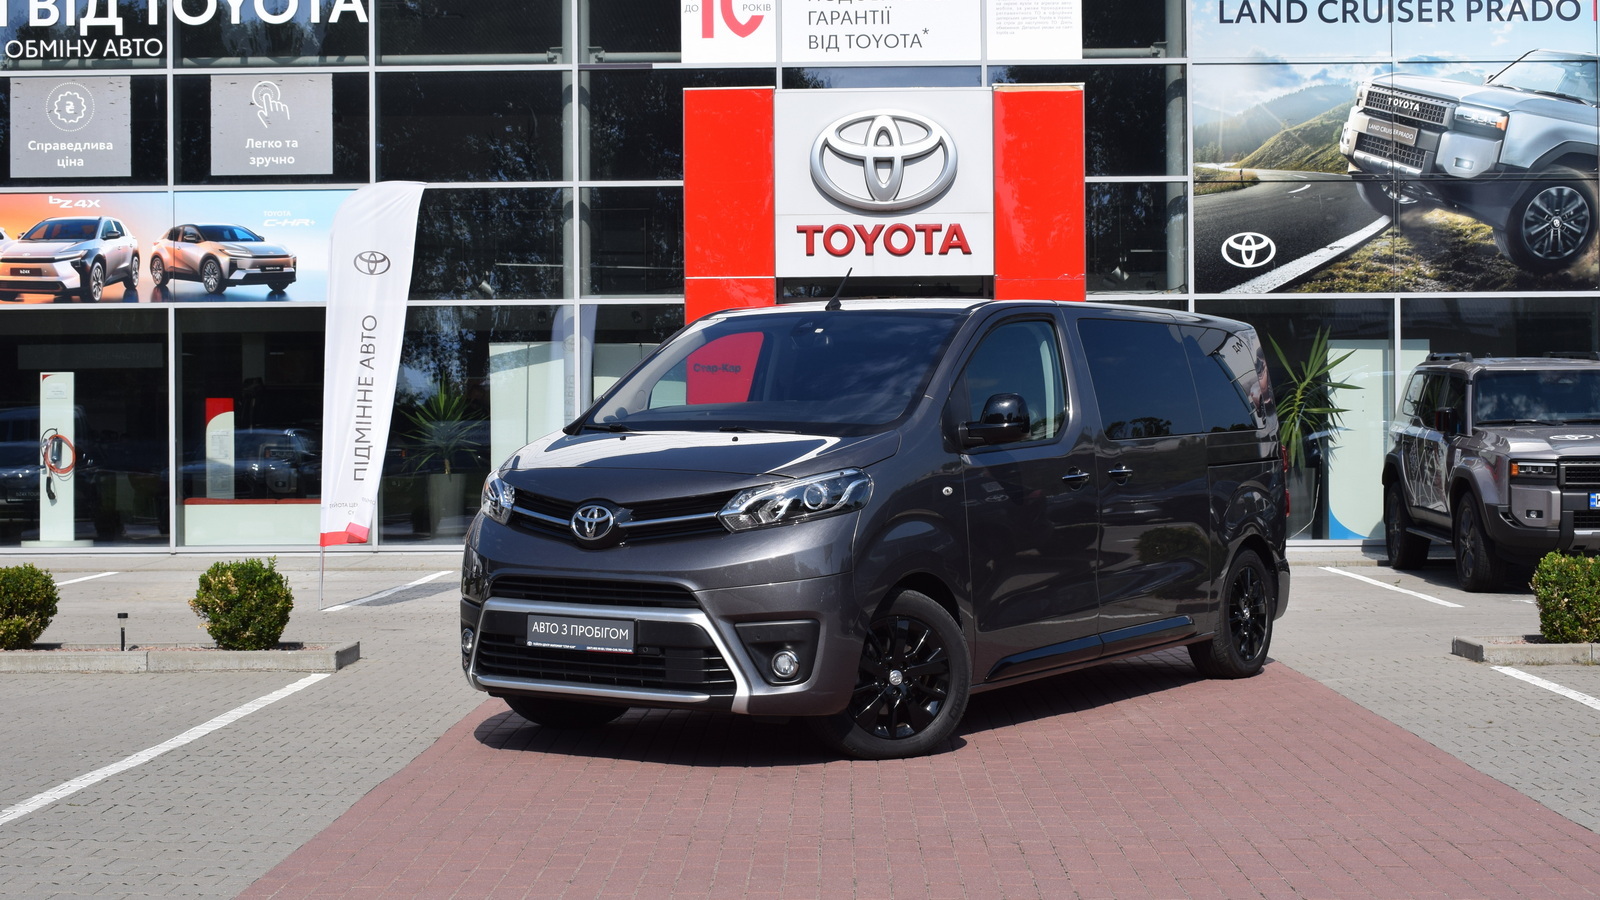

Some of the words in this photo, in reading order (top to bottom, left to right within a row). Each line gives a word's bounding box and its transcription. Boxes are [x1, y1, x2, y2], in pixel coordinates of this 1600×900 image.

[684, 4, 699, 14] ДО
[742, 3, 772, 12] РОКІВ
[808, 6, 892, 26] ГАРАНТІЇ
[1219, 0, 1308, 24] LAND
[1317, 0, 1456, 24] CRUISER
[1466, 0, 1581, 22] PRADO
[29, 0, 123, 36] ВІД
[5, 39, 98, 58] ОБМІНУ
[102, 38, 164, 57] АВТО
[808, 35, 840, 52] ВІД
[1387, 97, 1421, 112] TOYOTA
[28, 140, 114, 154] Справедлива
[245, 139, 283, 150] Легко
[283, 140, 299, 149] та
[57, 156, 85, 168] ціна
[248, 156, 296, 166] зручно
[796, 223, 972, 257] TOYOTA
[359, 314, 378, 371] АВТО
[693, 362, 742, 374] Стар-Кар
[353, 376, 375, 482] ПІДМІННЕ
[532, 621, 559, 635] АВТО
[570, 624, 629, 641] ПРОБІГОМ
